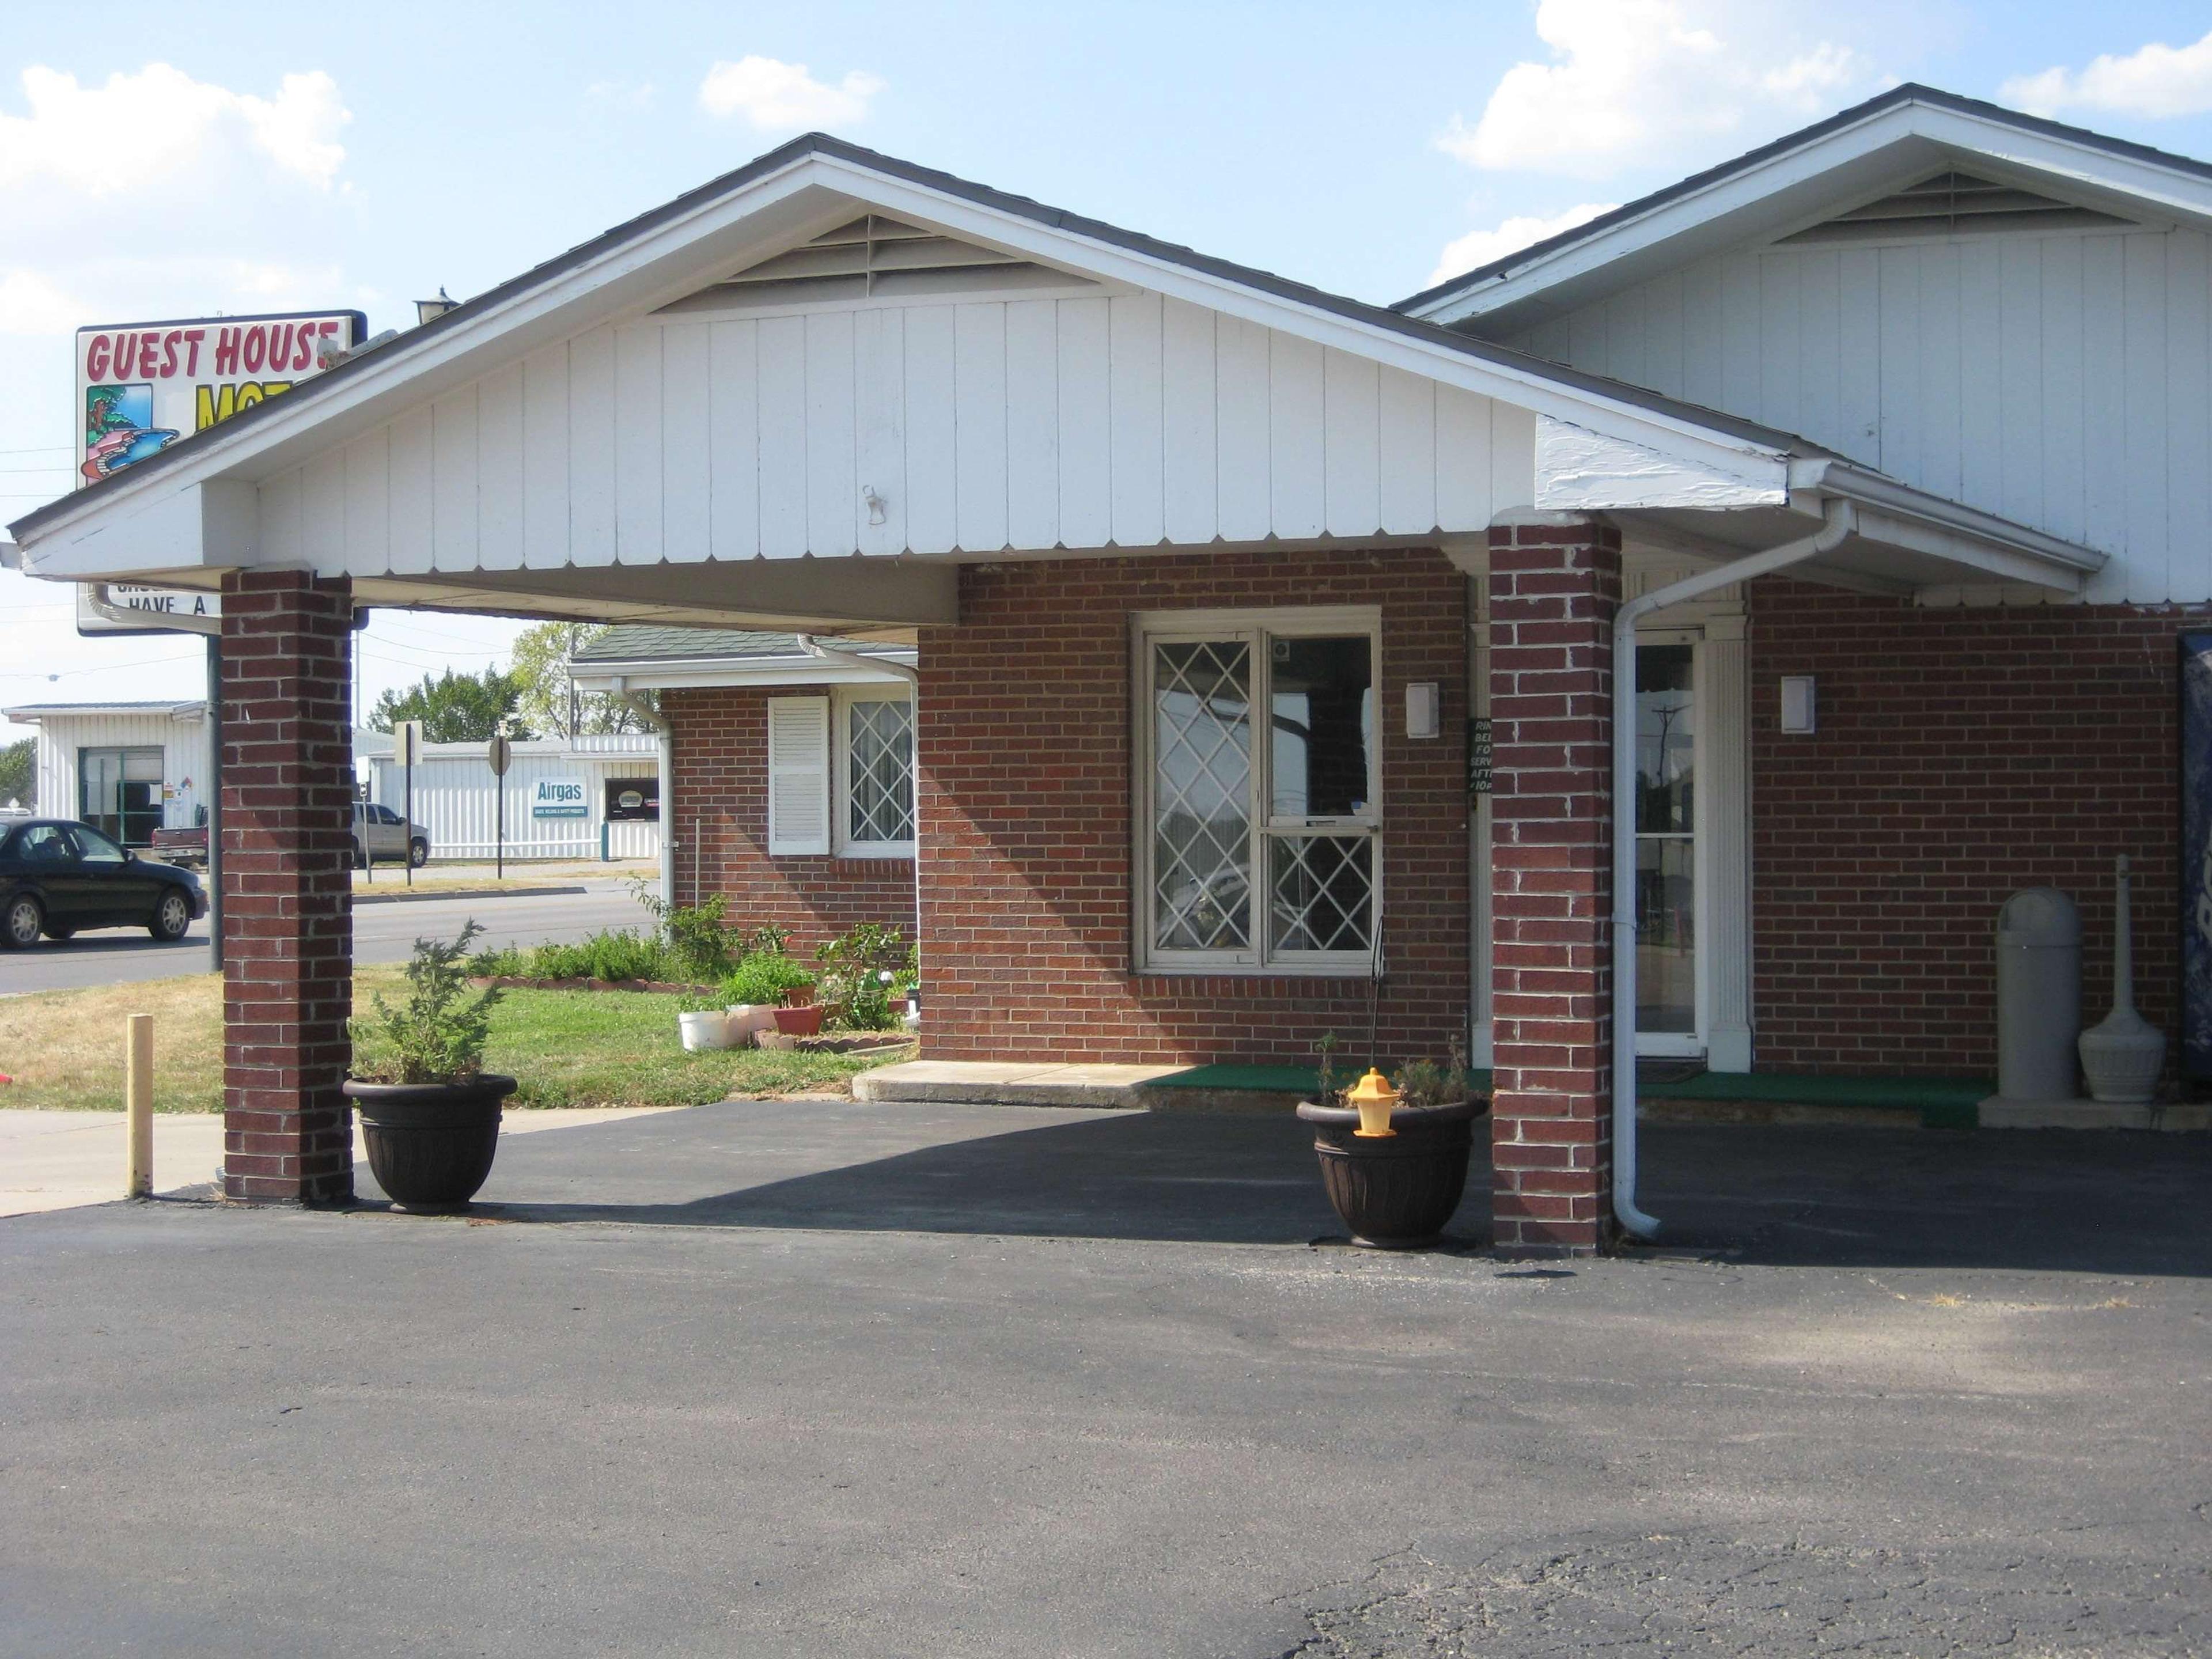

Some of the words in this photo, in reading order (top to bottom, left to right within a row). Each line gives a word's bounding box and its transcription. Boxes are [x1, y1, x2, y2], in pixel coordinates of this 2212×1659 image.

[86, 329, 205, 381] GUEST
[129, 597, 175, 613] HAVE
[194, 596, 206, 615] A
[1471, 769, 1492, 778] AFT
[537, 782, 582, 801] Airgas
